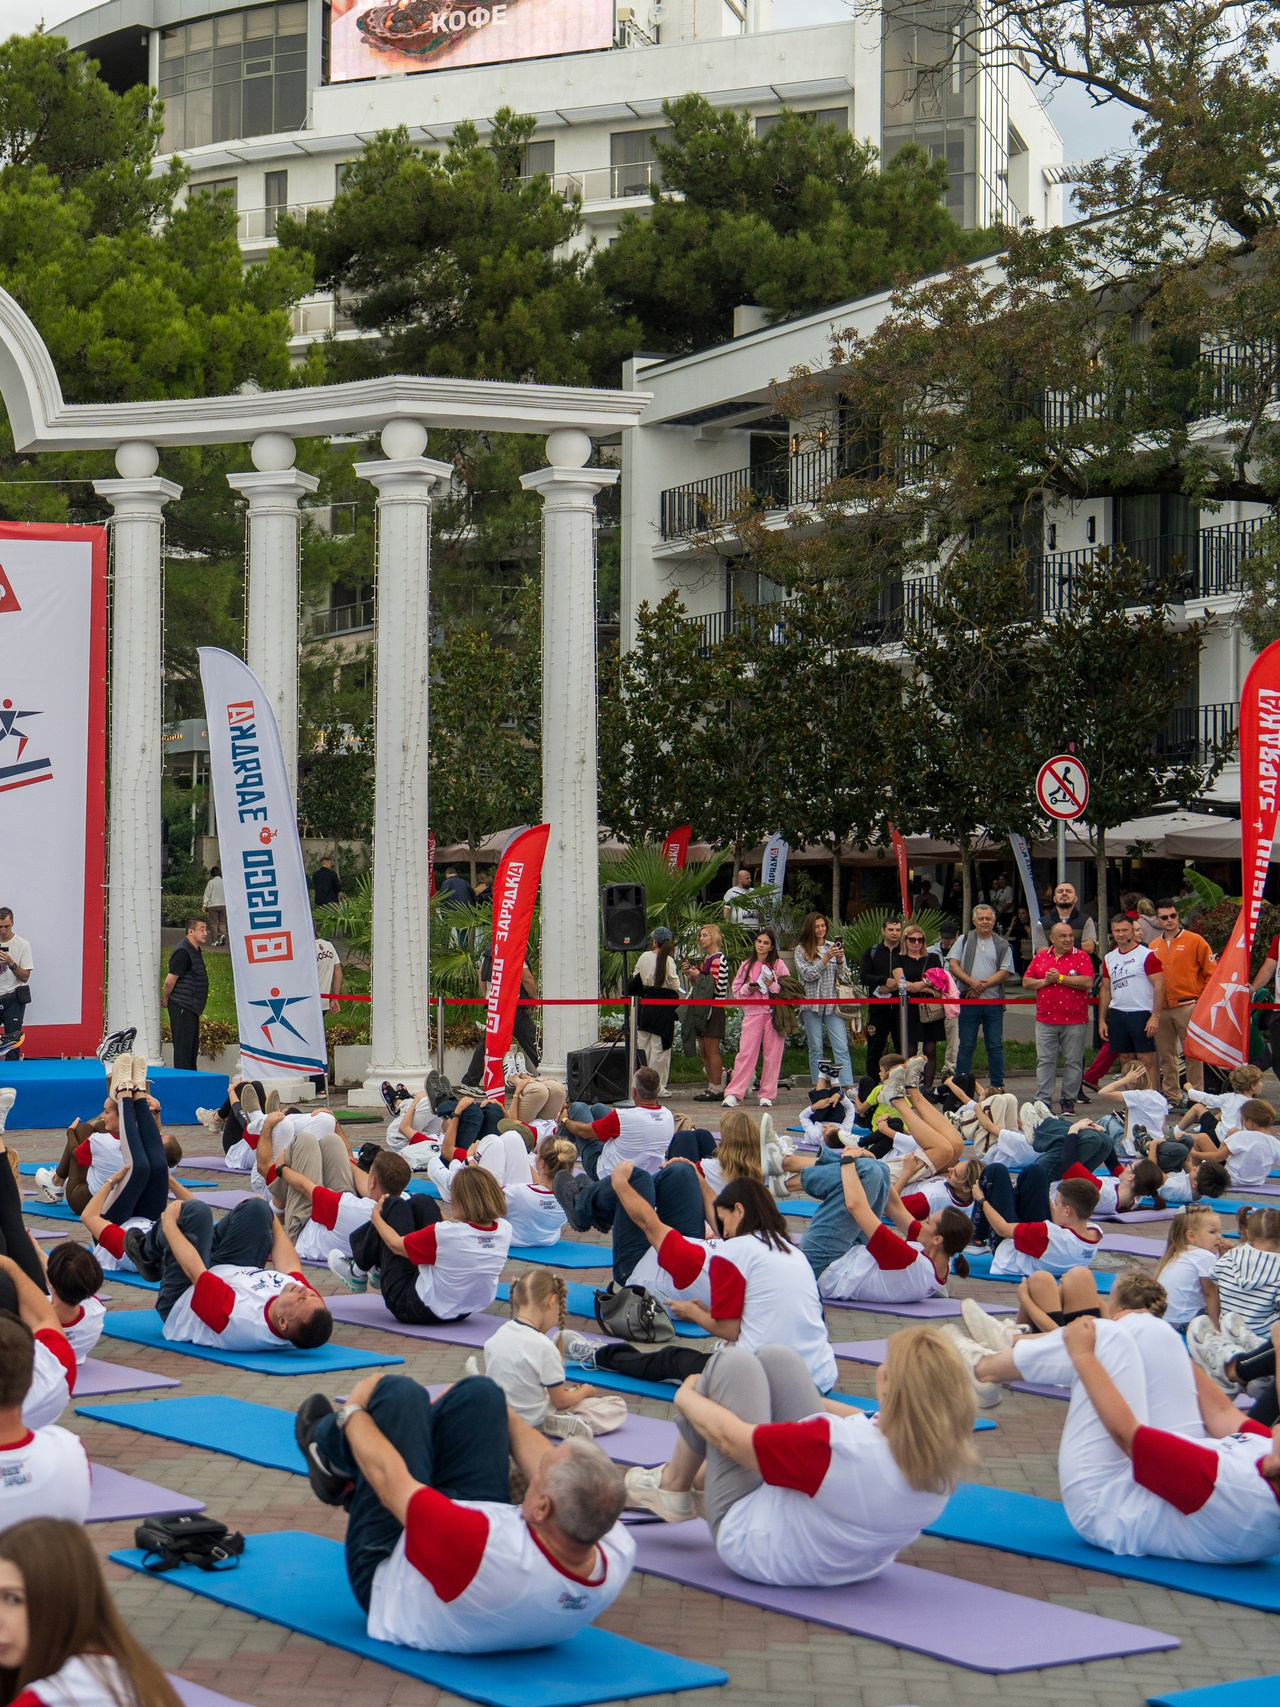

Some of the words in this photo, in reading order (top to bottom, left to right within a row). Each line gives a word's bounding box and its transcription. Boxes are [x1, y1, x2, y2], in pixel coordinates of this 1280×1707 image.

[432, 4, 507, 33] КОФЕ
[768, 848, 779, 884] АРЯДКА
[496, 862, 524, 941] ЗАРЯДКА
[316, 950, 333, 963] OSCO
